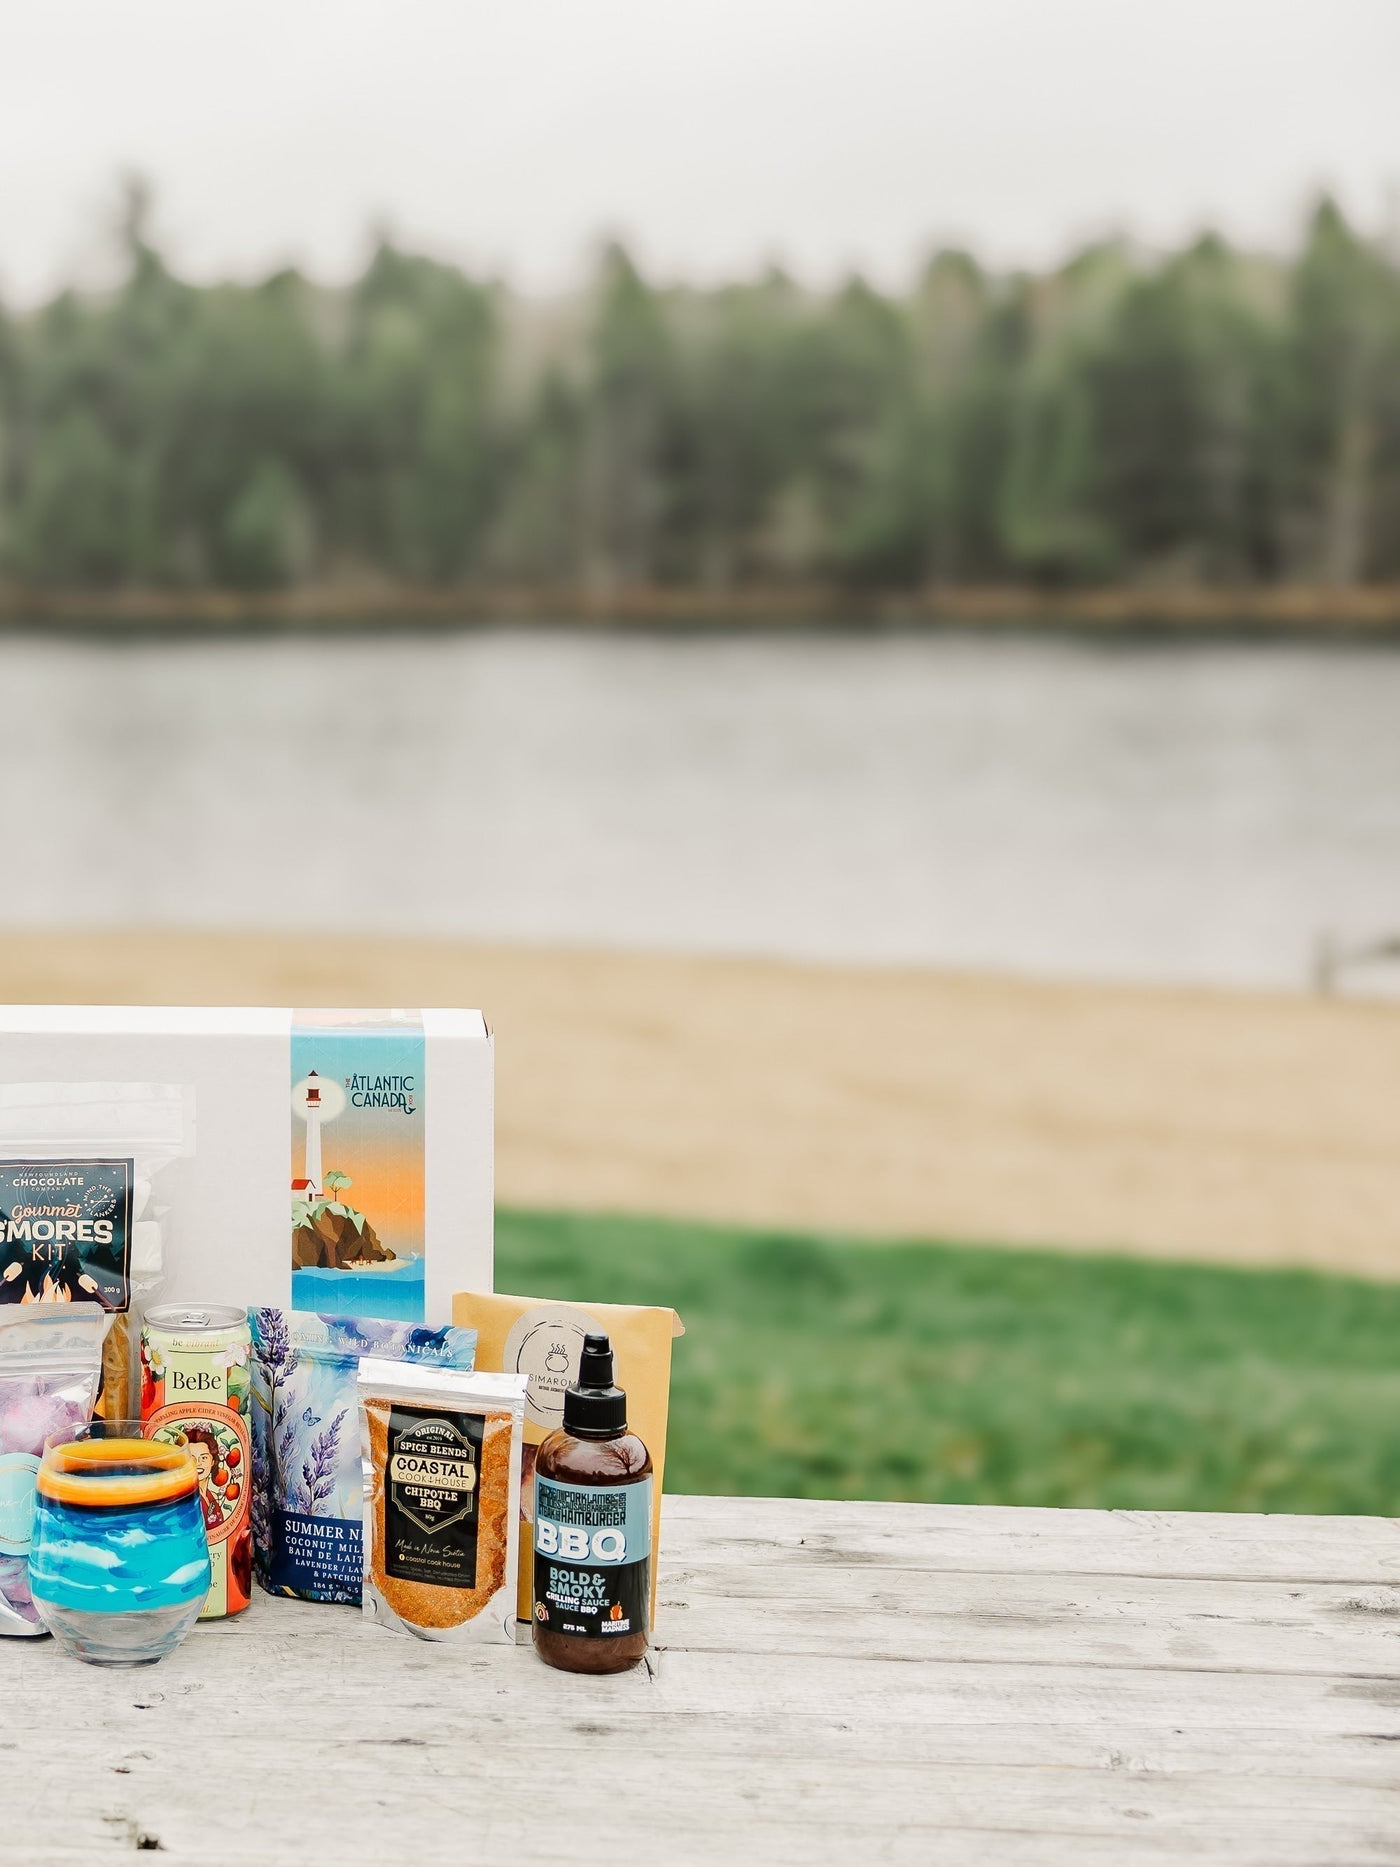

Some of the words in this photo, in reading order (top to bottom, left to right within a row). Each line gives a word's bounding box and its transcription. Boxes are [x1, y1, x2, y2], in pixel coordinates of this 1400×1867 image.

[350, 1073, 415, 1091] ATLANTIC
[351, 1092, 417, 1115] CANADA
[12, 1177, 85, 1187] CHOCOLATE
[83, 1185, 97, 1201] MIND
[98, 1184, 112, 1193] THE
[11, 1203, 83, 1224] Gourmet
[32, 1243, 67, 1262] KIT
[172, 1338, 183, 1347] be
[338, 1336, 368, 1348] WILD
[373, 1341, 454, 1358] BOTANICALS
[172, 1371, 222, 1391] BeBe
[179, 1407, 197, 1415] APPLE
[197, 1407, 217, 1415] CIDER
[415, 1426, 455, 1441] ORIGINAL
[400, 1441, 428, 1453] SPICE
[430, 1445, 468, 1458] BLENDS
[396, 1457, 469, 1479] COASTAL
[398, 1471, 427, 1483] COOK
[435, 1477, 467, 1488] HOUSE
[404, 1486, 458, 1501] CHIPOTLE
[420, 1498, 442, 1511] BBQ
[561, 1509, 627, 1527] HAMBURGER
[284, 1519, 345, 1540] SUMMER
[285, 1535, 334, 1550] COCONUT
[338, 1543, 363, 1554] MIL
[537, 1517, 627, 1563] BBQ
[288, 1546, 313, 1558] BAIN
[318, 1551, 332, 1560] DE
[337, 1553, 363, 1564] LAIT
[405, 1555, 427, 1564] coastal
[427, 1558, 442, 1567] cook
[442, 1561, 461, 1569] house
[295, 1558, 339, 1571] LAVENDER
[549, 1566, 591, 1585] BOLD
[592, 1573, 606, 1586] &
[545, 1591, 580, 1606] GRILLING
[581, 1598, 610, 1606] SAUCE
[549, 1580, 606, 1599] SMOKY
[555, 1601, 580, 1612] SAUCE
[580, 1606, 598, 1615] BBQ
